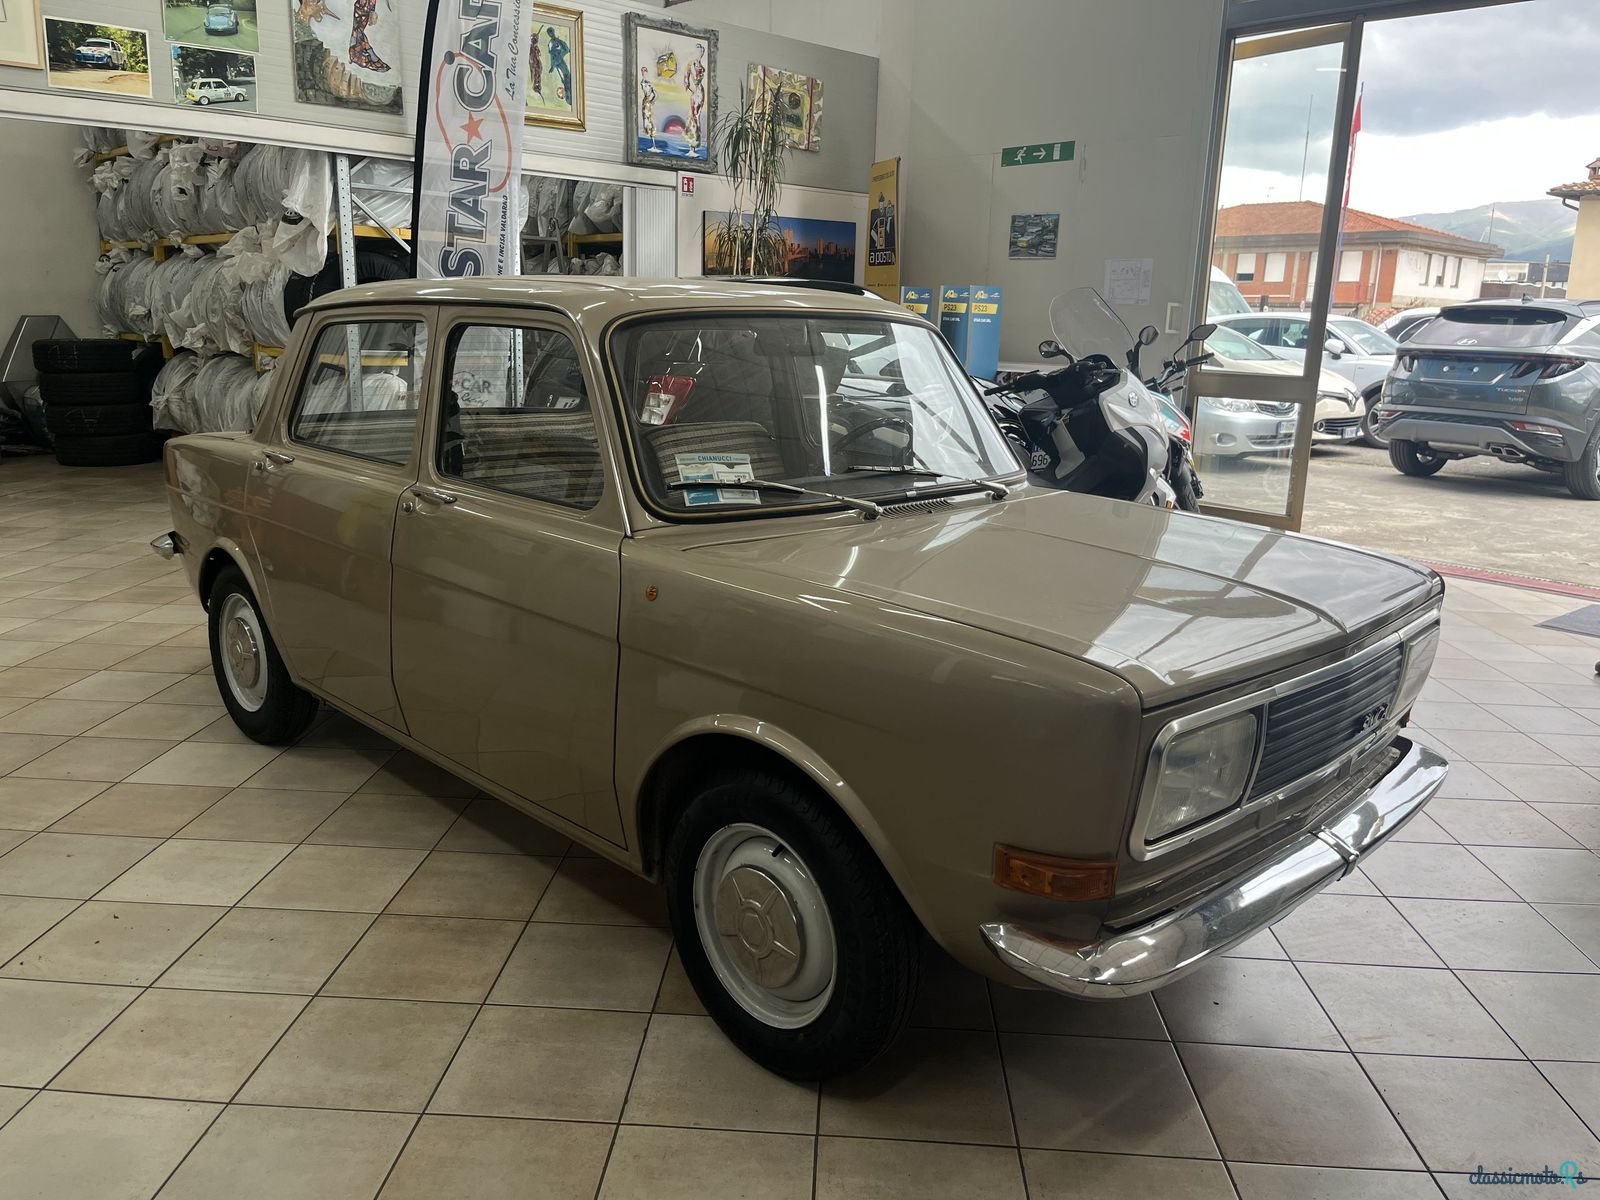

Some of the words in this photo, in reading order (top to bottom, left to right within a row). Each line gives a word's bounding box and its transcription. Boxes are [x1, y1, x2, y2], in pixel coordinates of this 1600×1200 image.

[506, 56, 517, 80] Tua
[505, 83, 515, 100] La
[438, 139, 493, 278] STAR
[500, 194, 508, 232] VALDARNO
[973, 304, 988, 312] PS23
[461, 379, 491, 394] CAR
